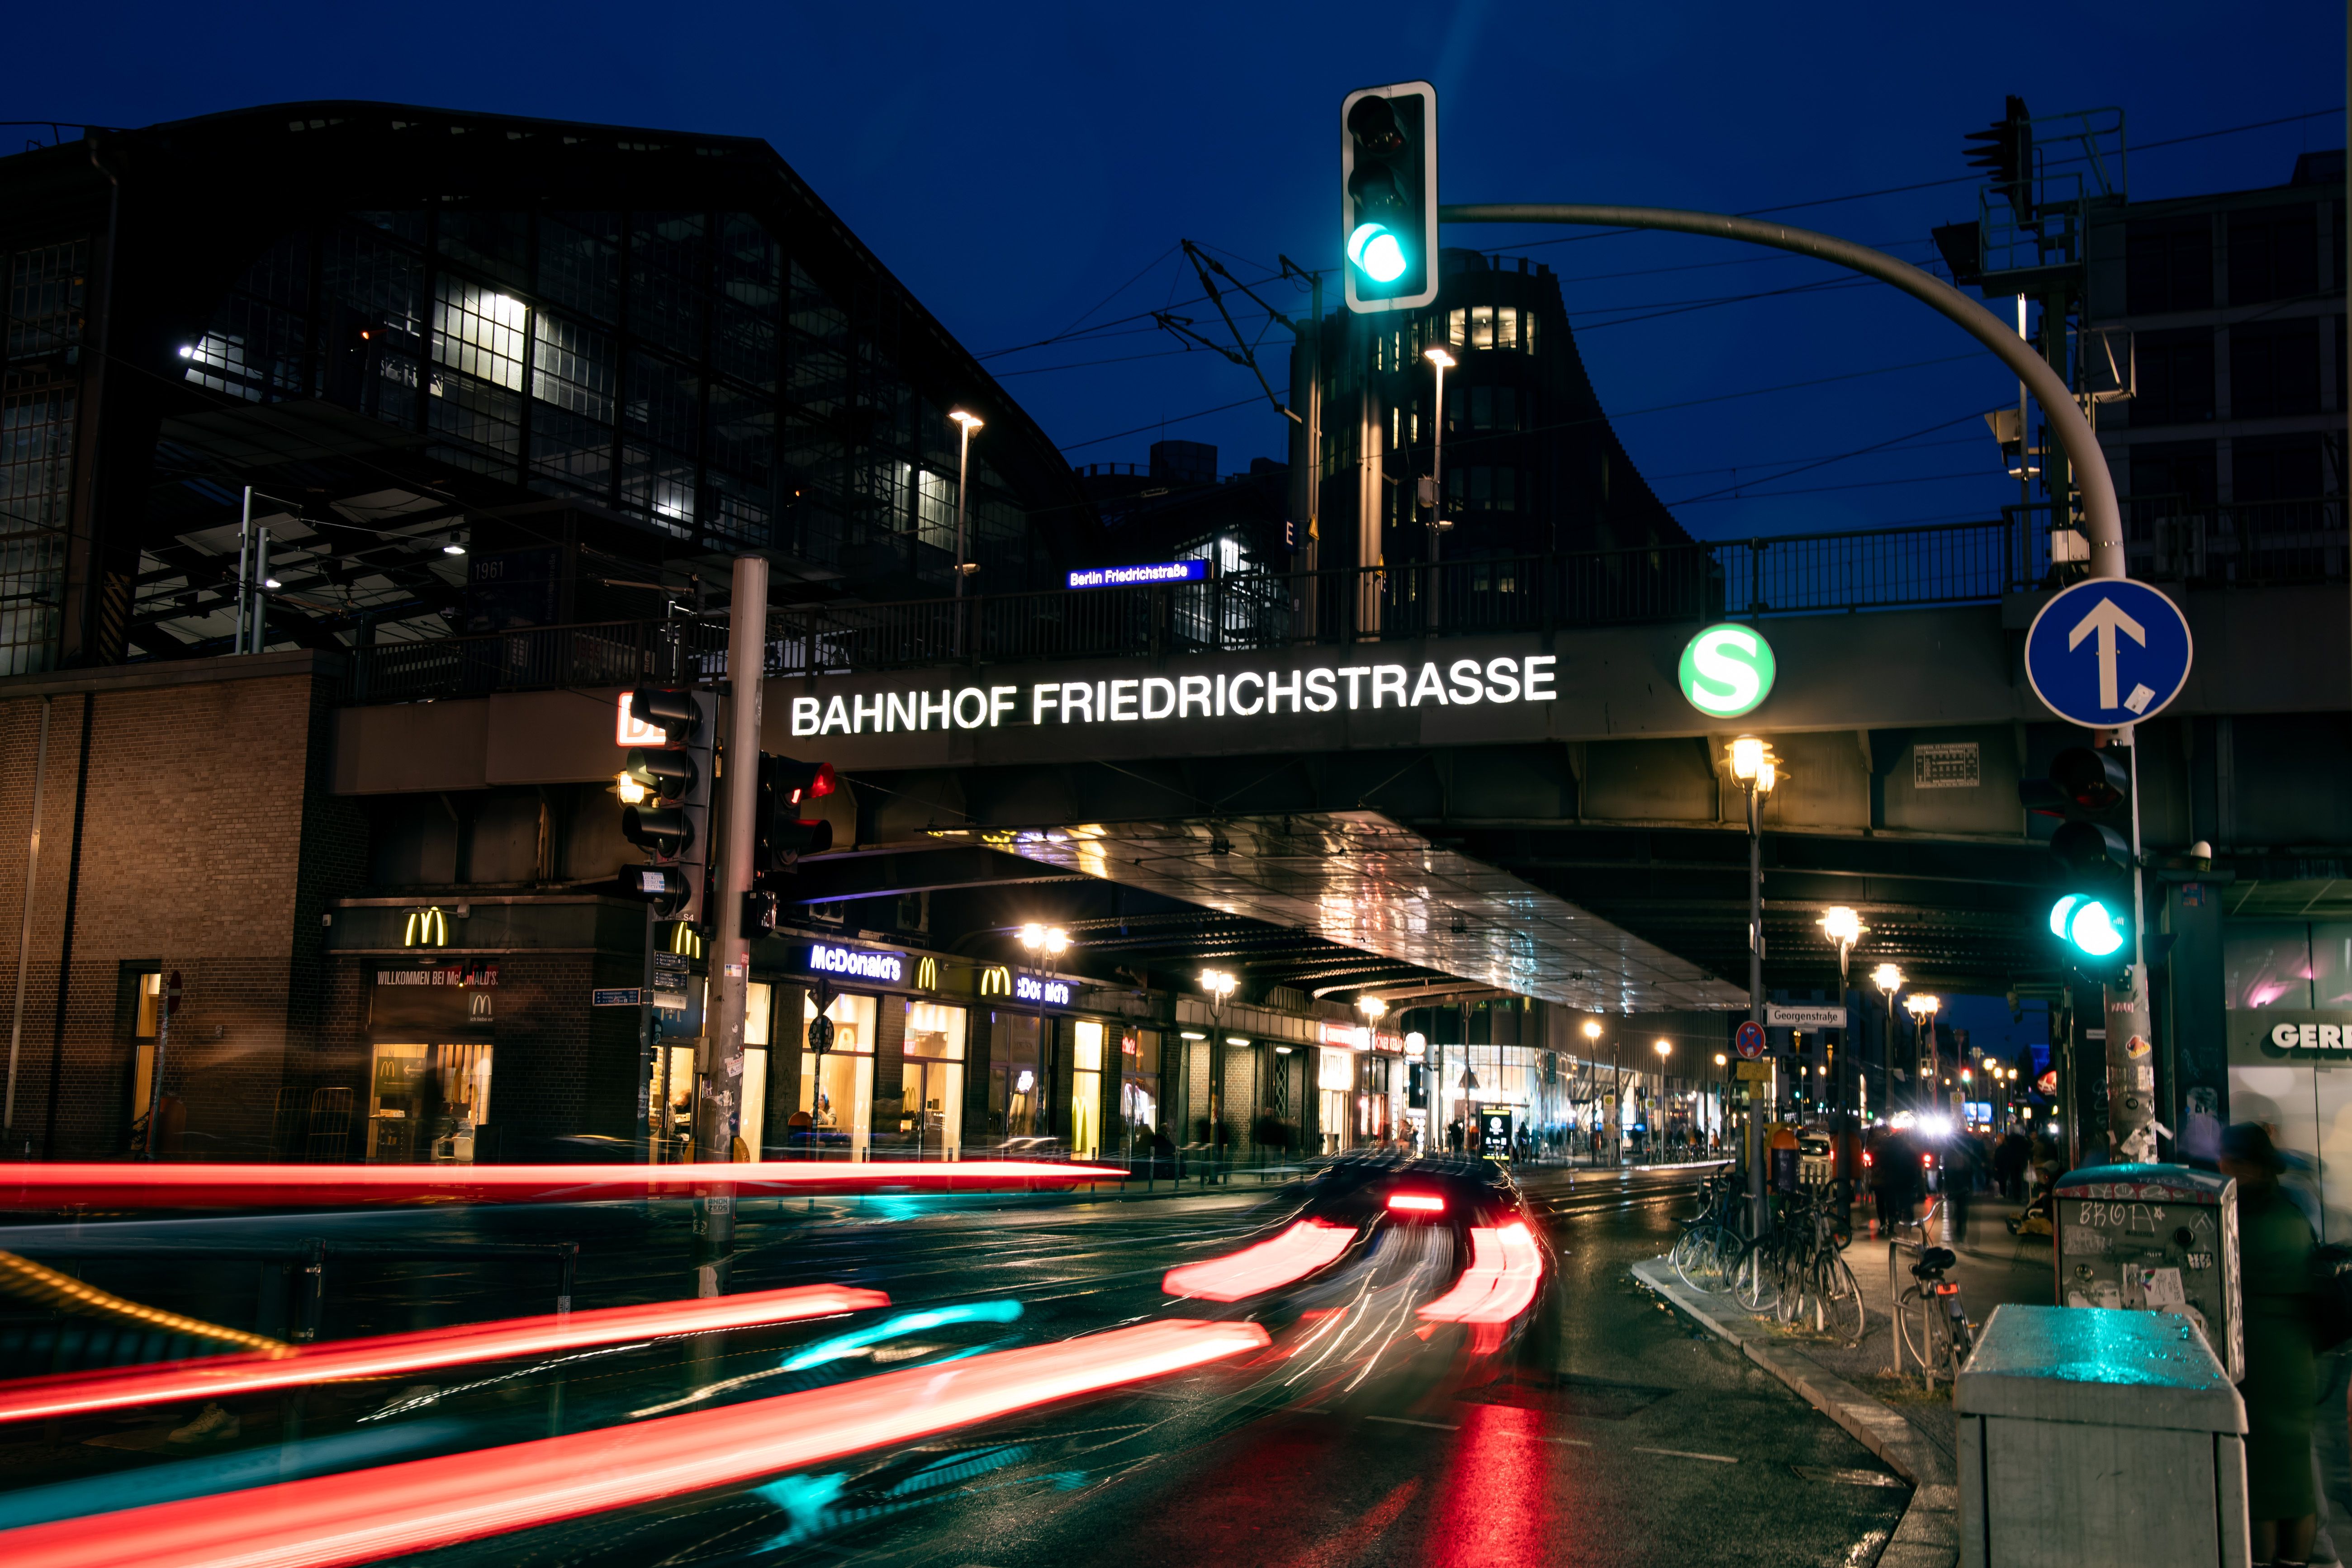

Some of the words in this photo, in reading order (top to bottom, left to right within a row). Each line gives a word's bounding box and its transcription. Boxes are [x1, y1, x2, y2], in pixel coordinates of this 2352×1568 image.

[1286, 521, 1293, 545] E
[475, 560, 504, 581] 1961
[1070, 572, 1102, 586] Berlin
[1105, 564, 1188, 583] Friedrichstraße
[1693, 630, 1759, 712] S
[792, 685, 1017, 736] BAHNHOF
[1034, 656, 1556, 725] FRIEDRICHSTRASSE
[683, 914, 694, 922] S4
[811, 945, 901, 981] McDonald's
[377, 971, 430, 985] WILLKOMMEN
[432, 971, 444, 985] BEI
[1774, 1010, 1838, 1023] Georgenstraße
